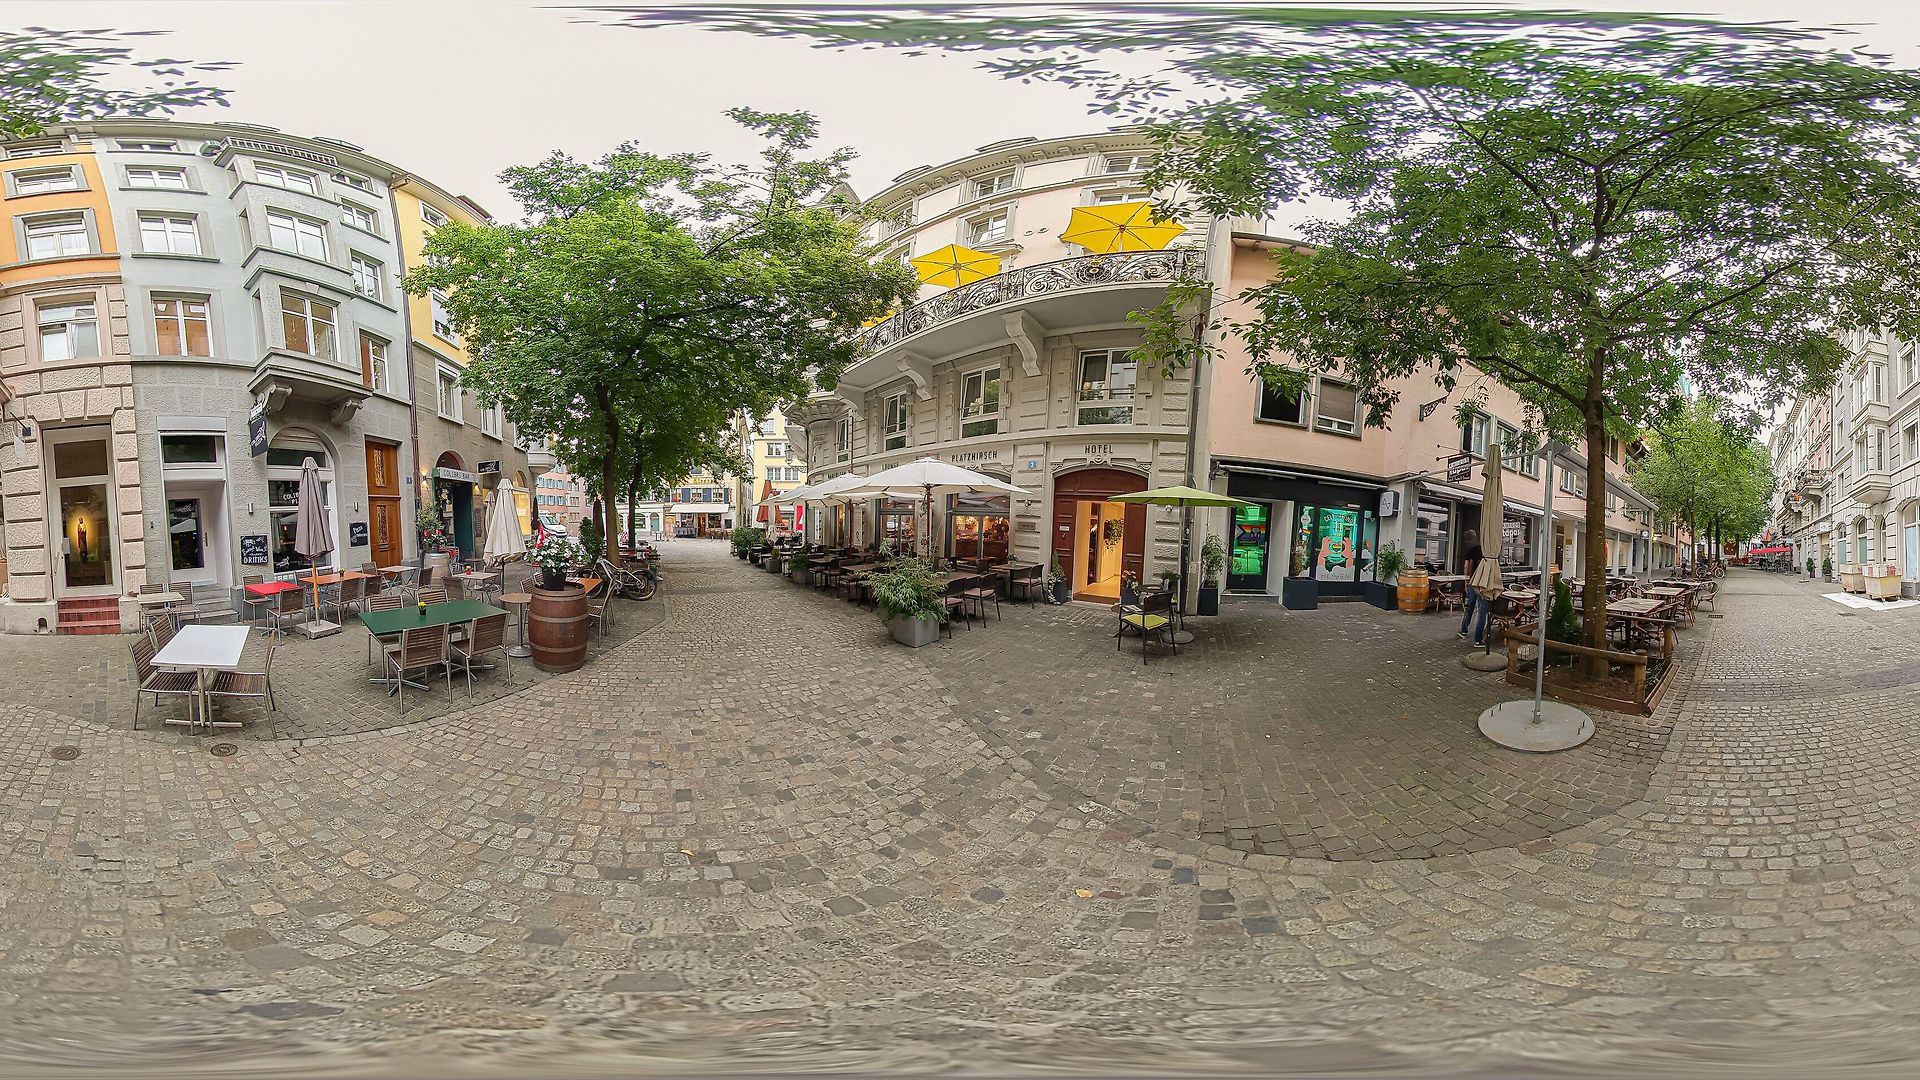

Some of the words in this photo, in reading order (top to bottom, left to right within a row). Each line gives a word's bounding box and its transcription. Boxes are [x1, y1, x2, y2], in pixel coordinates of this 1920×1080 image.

[1084, 444, 1114, 454] HOTEL
[951, 450, 998, 463] PLATZHIRSCH
[243, 555, 268, 564] DRINKS
